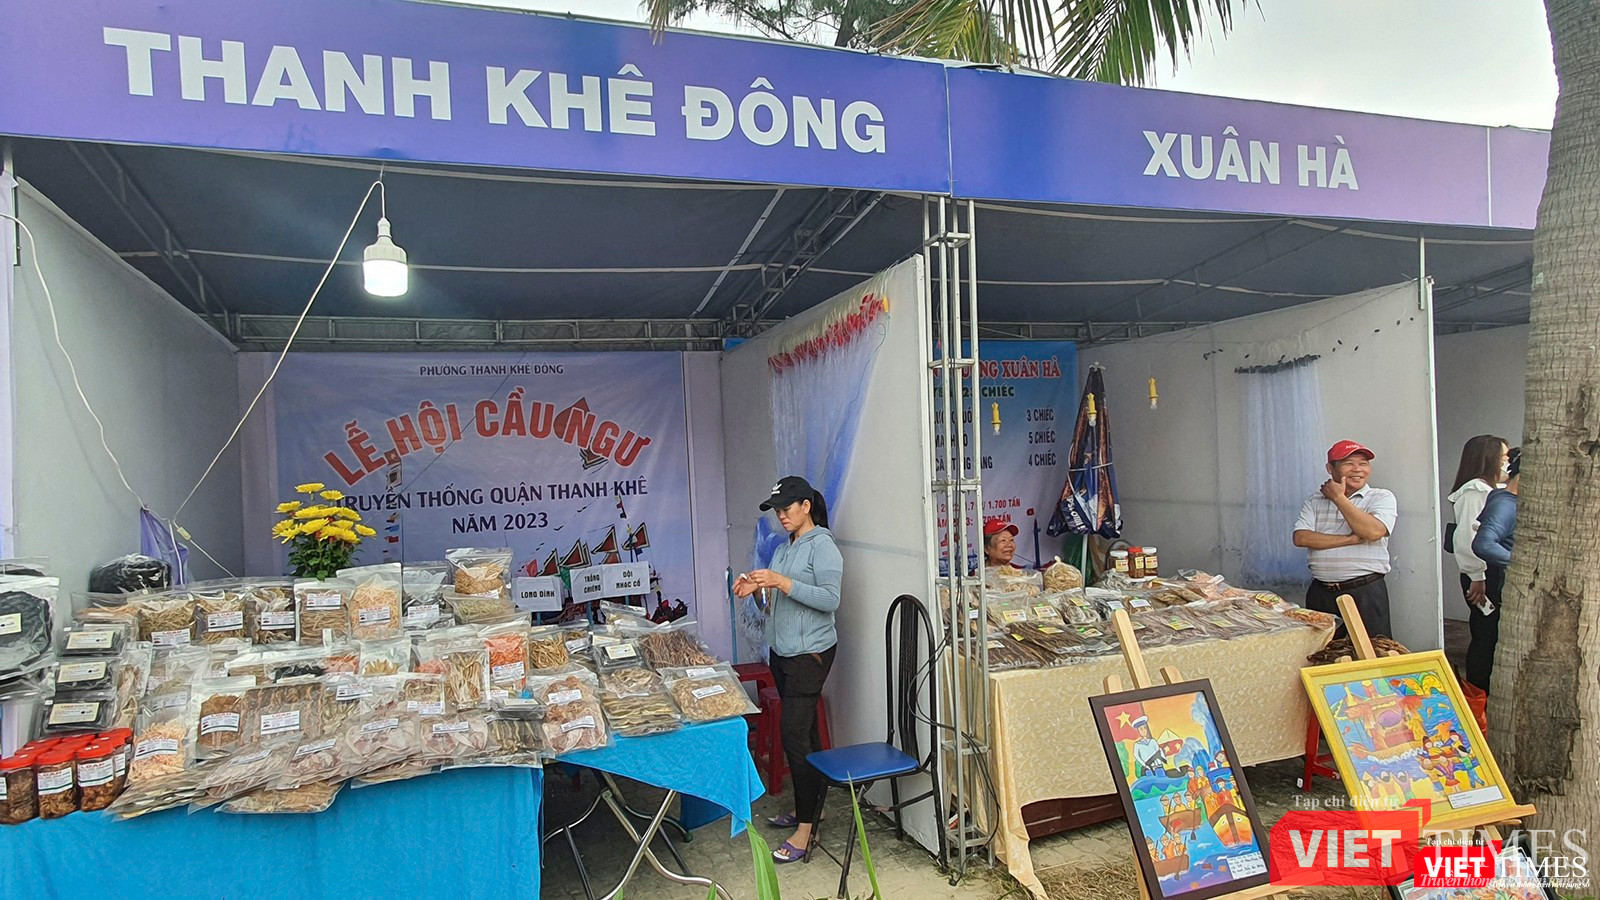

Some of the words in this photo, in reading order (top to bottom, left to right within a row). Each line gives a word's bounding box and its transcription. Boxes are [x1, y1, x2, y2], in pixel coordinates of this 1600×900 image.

[103, 26, 452, 121] THANH
[486, 64, 656, 137] KHÊ
[681, 76, 886, 154] ĐÔNG
[1143, 126, 1281, 186] XUÂN
[1298, 135, 1360, 191] HÀ
[419, 362, 467, 376] PHƯỜNG
[469, 364, 506, 375] THANH
[509, 362, 531, 375] KHÊ
[533, 362, 564, 375] ĐÔNG
[1001, 356, 1040, 379] XUÂN
[1041, 357, 1061, 379] HÀ
[1026, 409, 1032, 422] 3
[323, 420, 387, 486] LỄ
[386, 400, 462, 457] HỘI
[475, 386, 555, 439] CẦU
[563, 407, 652, 468] NGƯ
[1028, 431, 1034, 445] 5
[1028, 454, 1034, 467] 4
[416, 481, 485, 507] THỐNG
[489, 481, 544, 507] QUẬN
[548, 480, 609, 501] THANH
[614, 474, 649, 497] KHÊ
[987, 500, 1007, 509] 1.700
[452, 508, 498, 536] NĂM
[501, 512, 549, 535] 2023
